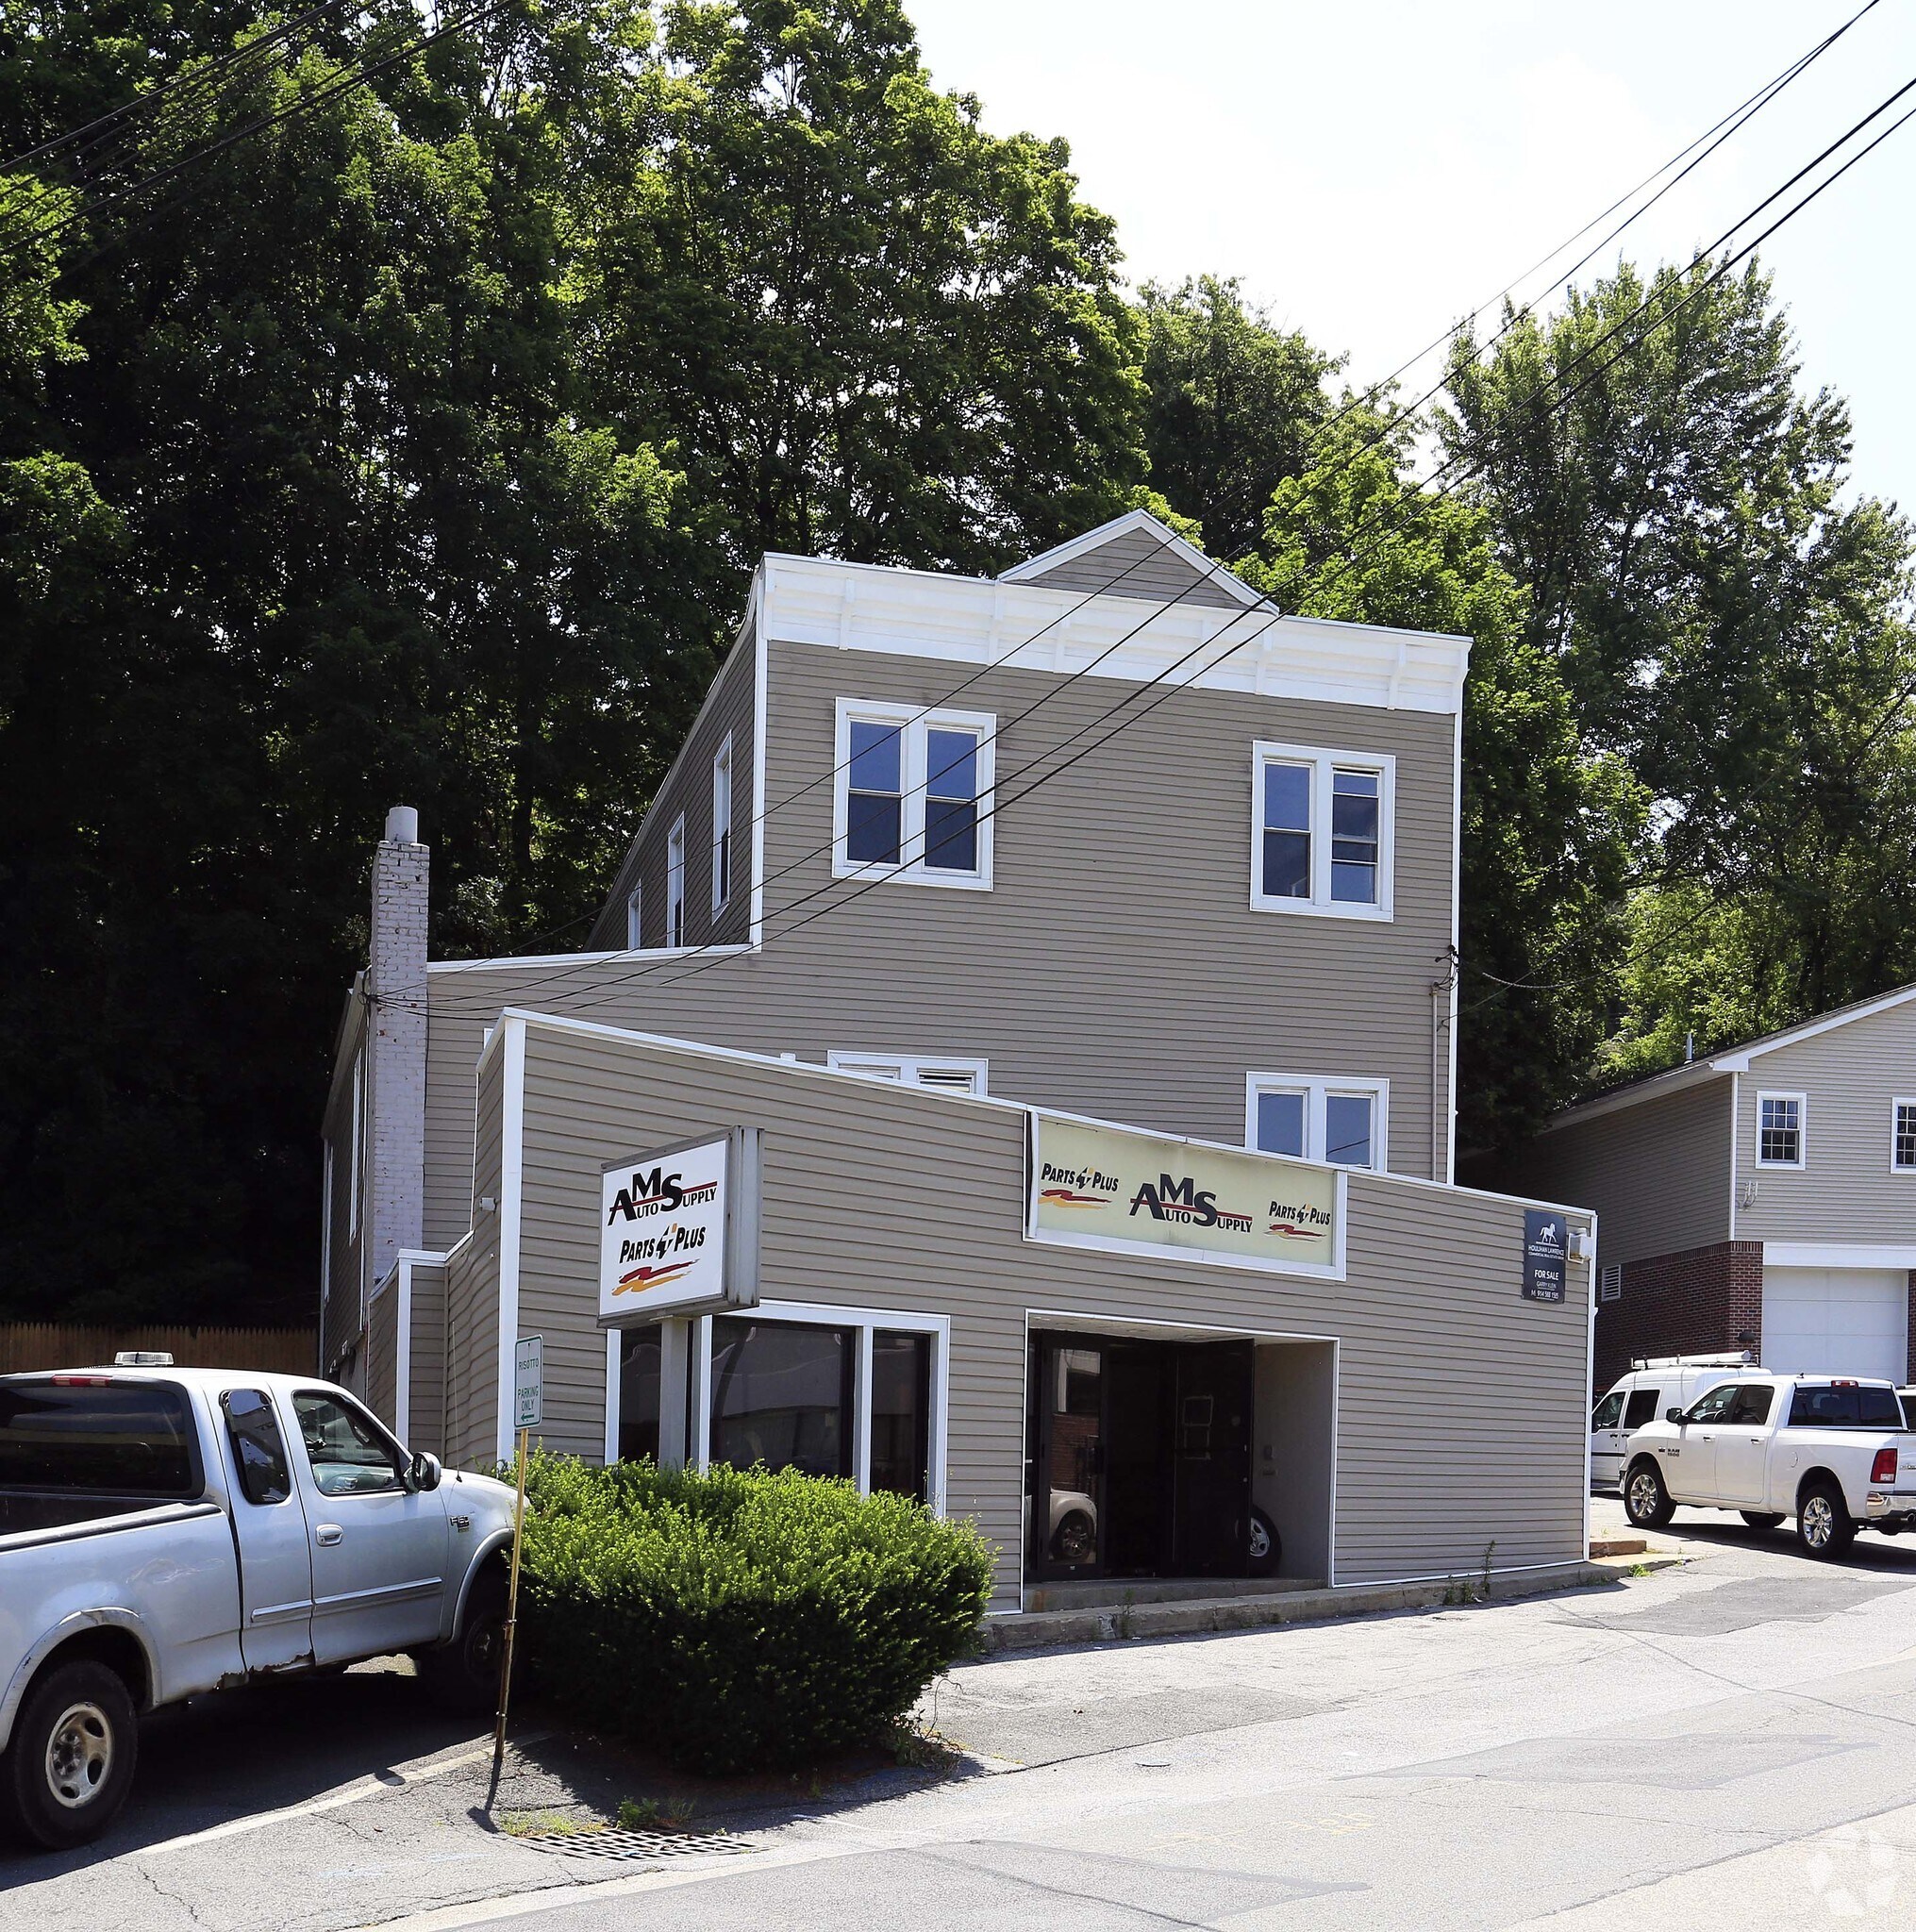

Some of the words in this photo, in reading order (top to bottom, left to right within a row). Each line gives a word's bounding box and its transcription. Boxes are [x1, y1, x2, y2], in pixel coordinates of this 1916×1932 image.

[1041, 1163, 1075, 1185] PARTS
[1091, 1172, 1119, 1191] PLUS
[1269, 1201, 1297, 1220] PARTS
[1309, 1208, 1331, 1225] PLUS
[619, 1239, 655, 1264] PARTS
[674, 1226, 706, 1252] PLUS
[1534, 1269, 1545, 1278] FOR
[1546, 1271, 1559, 1280] SALE
[518, 1358, 539, 1370] RISOTTO
[518, 1386, 539, 1399] PARKING
[521, 1399, 534, 1411] ONLY
